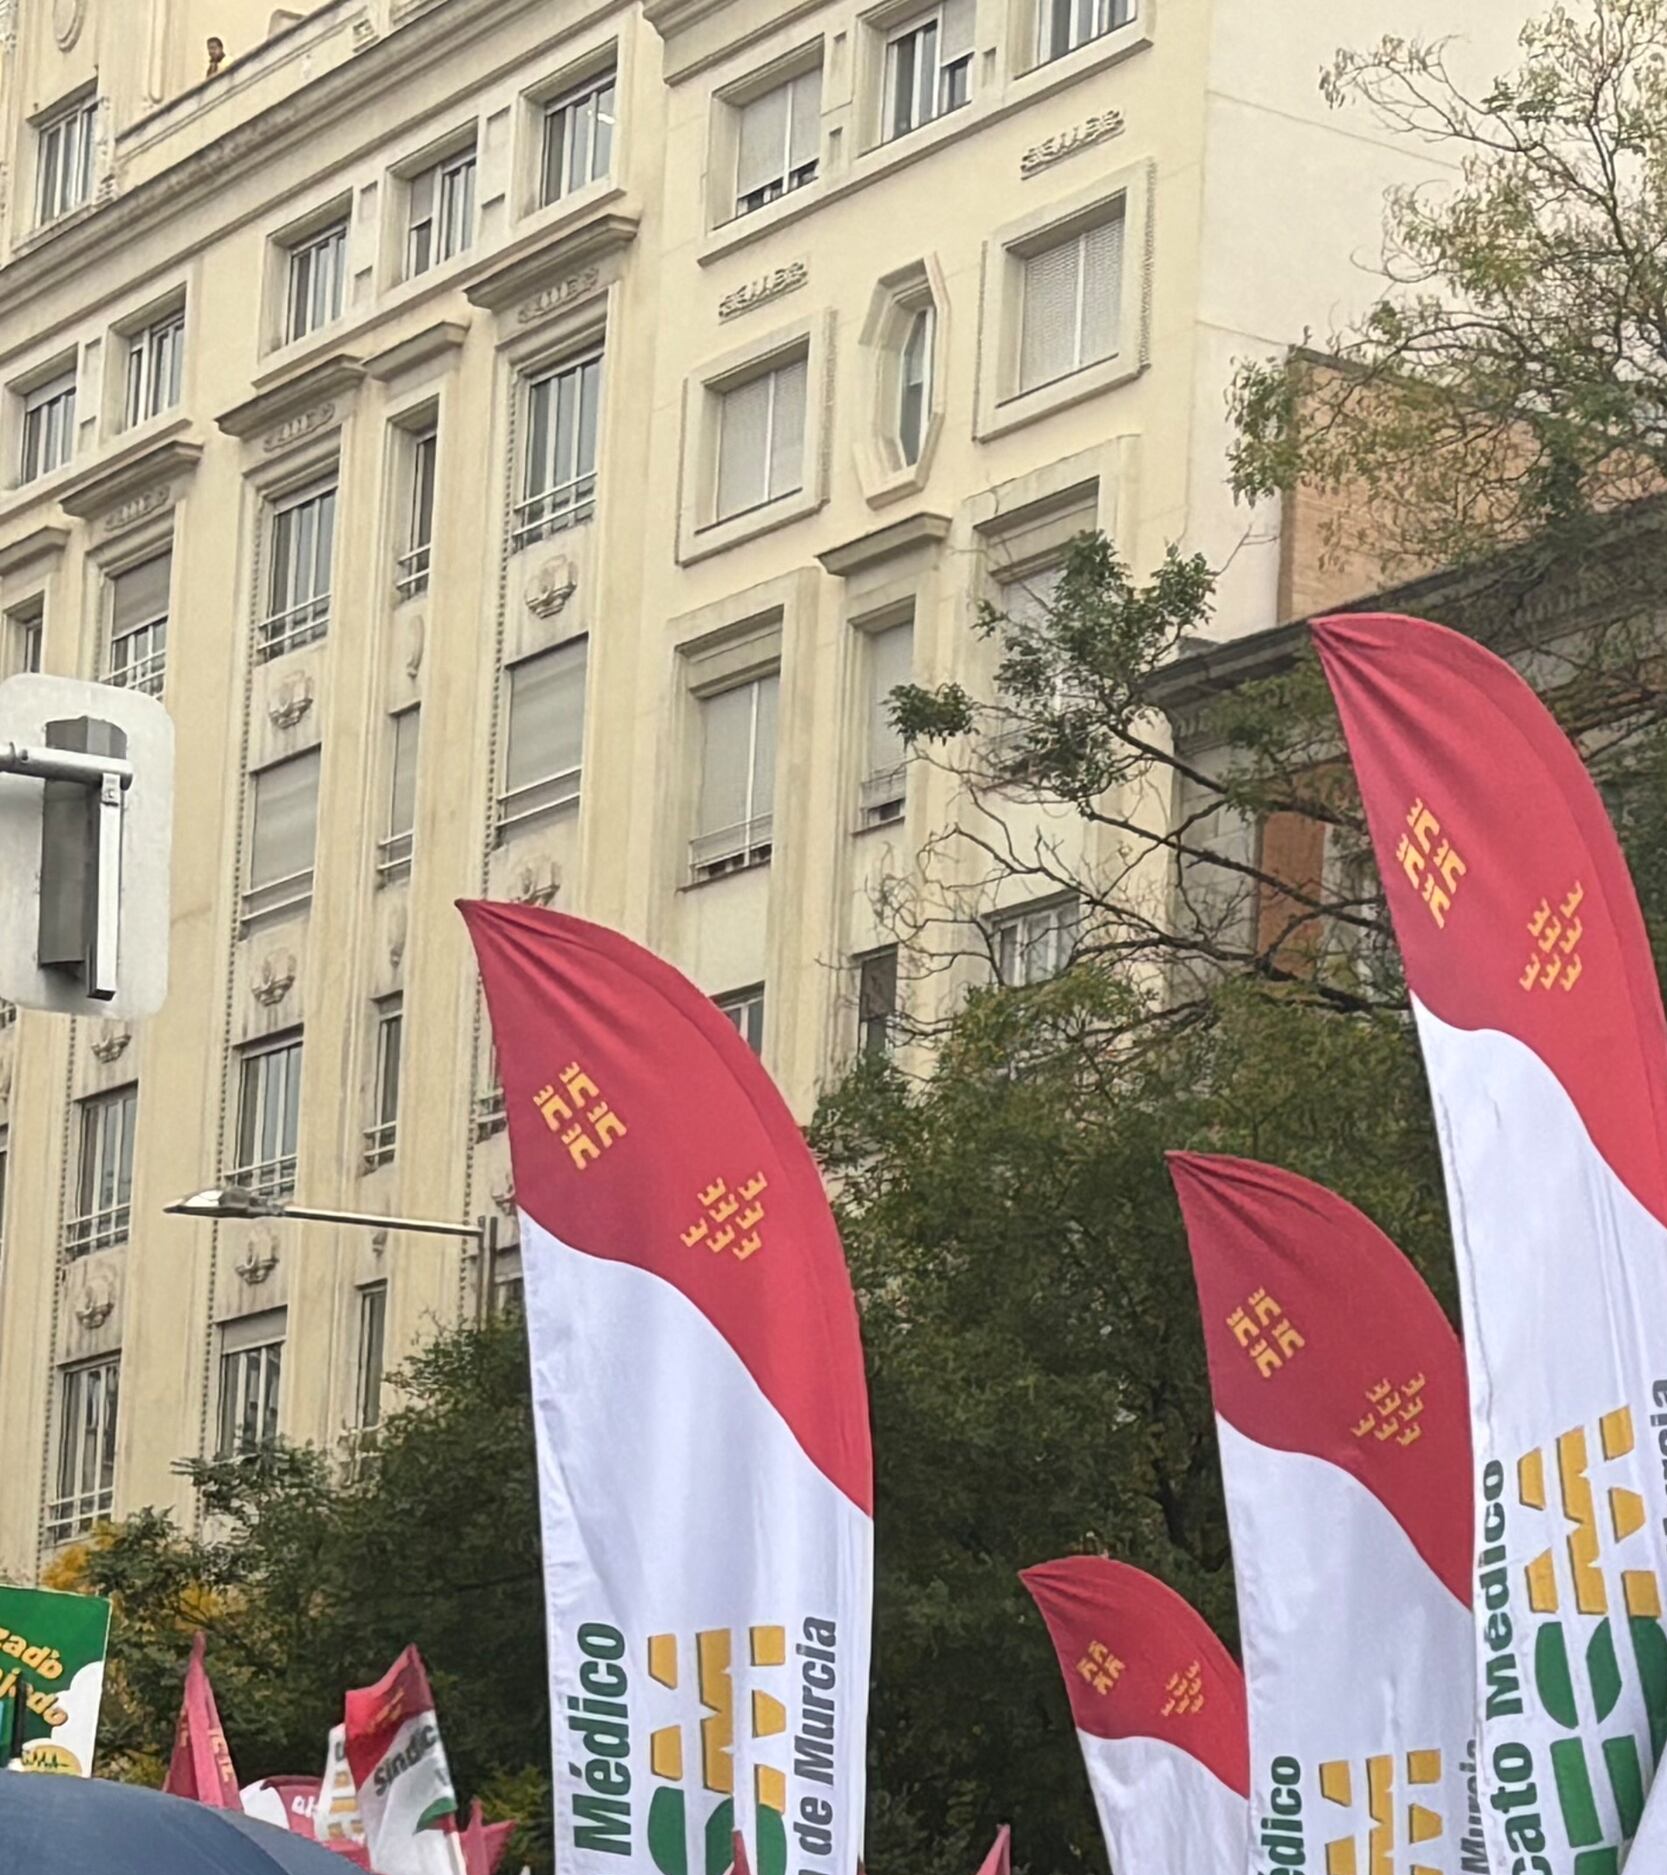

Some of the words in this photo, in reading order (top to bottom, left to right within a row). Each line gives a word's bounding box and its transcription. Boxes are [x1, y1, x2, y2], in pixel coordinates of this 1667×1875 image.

[1479, 1460, 1523, 1721] Médico
[568, 1622, 632, 1857] Médico
[794, 1617, 837, 1790] Murcia
[794, 1797, 833, 1855] de
